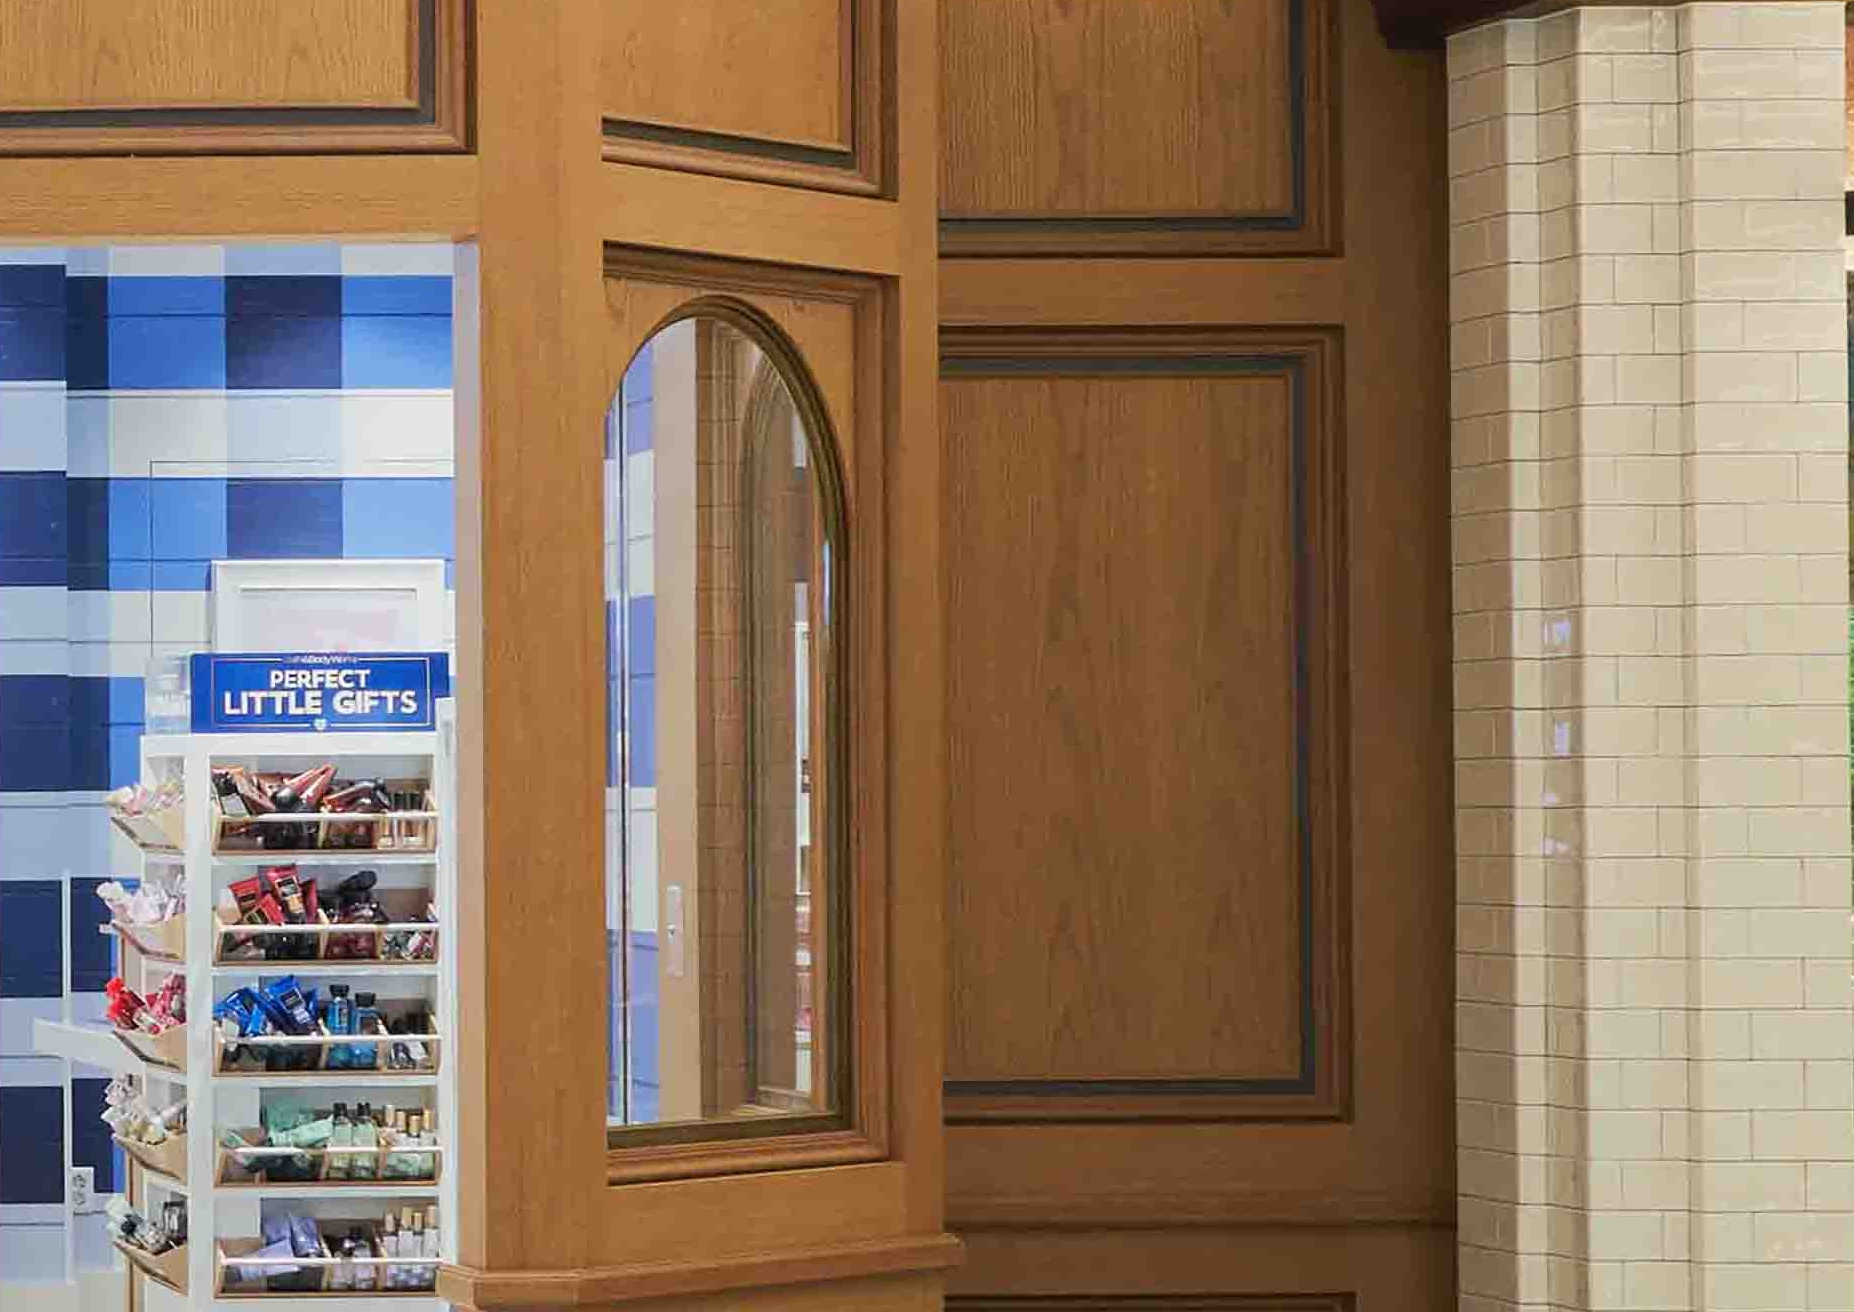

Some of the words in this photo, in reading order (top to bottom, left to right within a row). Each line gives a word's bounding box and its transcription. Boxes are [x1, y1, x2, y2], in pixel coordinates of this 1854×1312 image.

[270, 669, 371, 689] PERFECT
[223, 692, 323, 715] LITTLE
[332, 691, 419, 715] GIFTS
